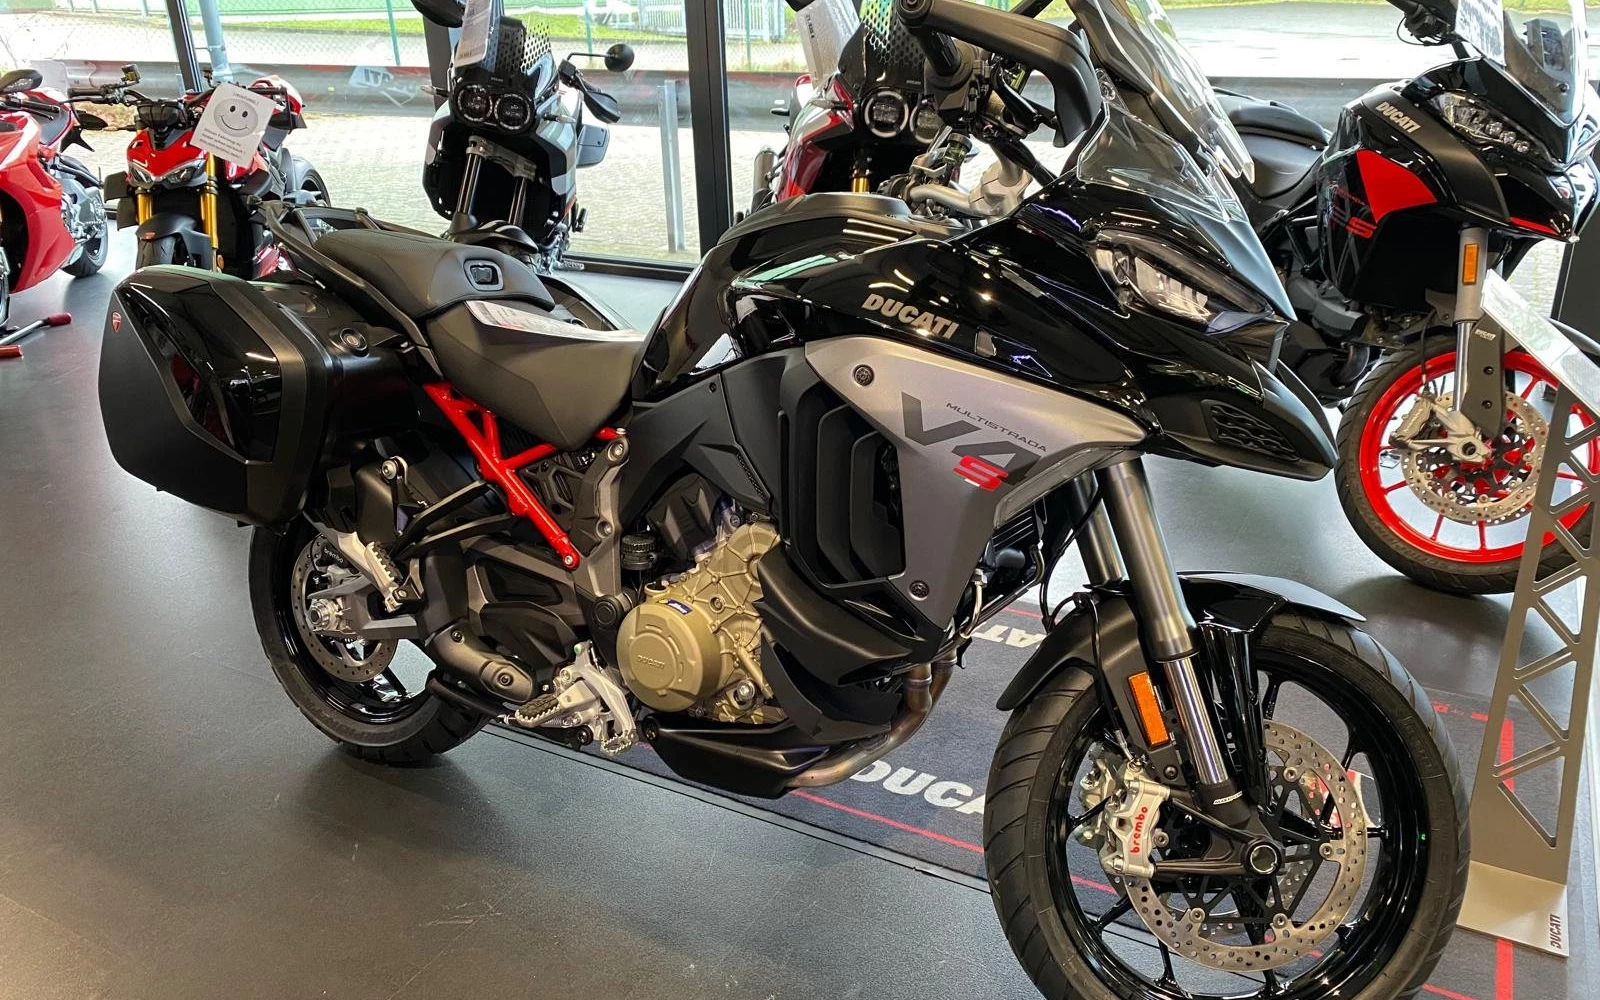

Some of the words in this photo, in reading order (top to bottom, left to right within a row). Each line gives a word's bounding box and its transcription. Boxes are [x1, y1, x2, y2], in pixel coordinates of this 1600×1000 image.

[1375, 101, 1421, 133] DUCATI
[861, 293, 959, 339] DUCATI
[945, 401, 1048, 453] MULTISTRADA
[1129, 805, 1149, 854] brembo
[1549, 914, 1562, 949] DUCATI
